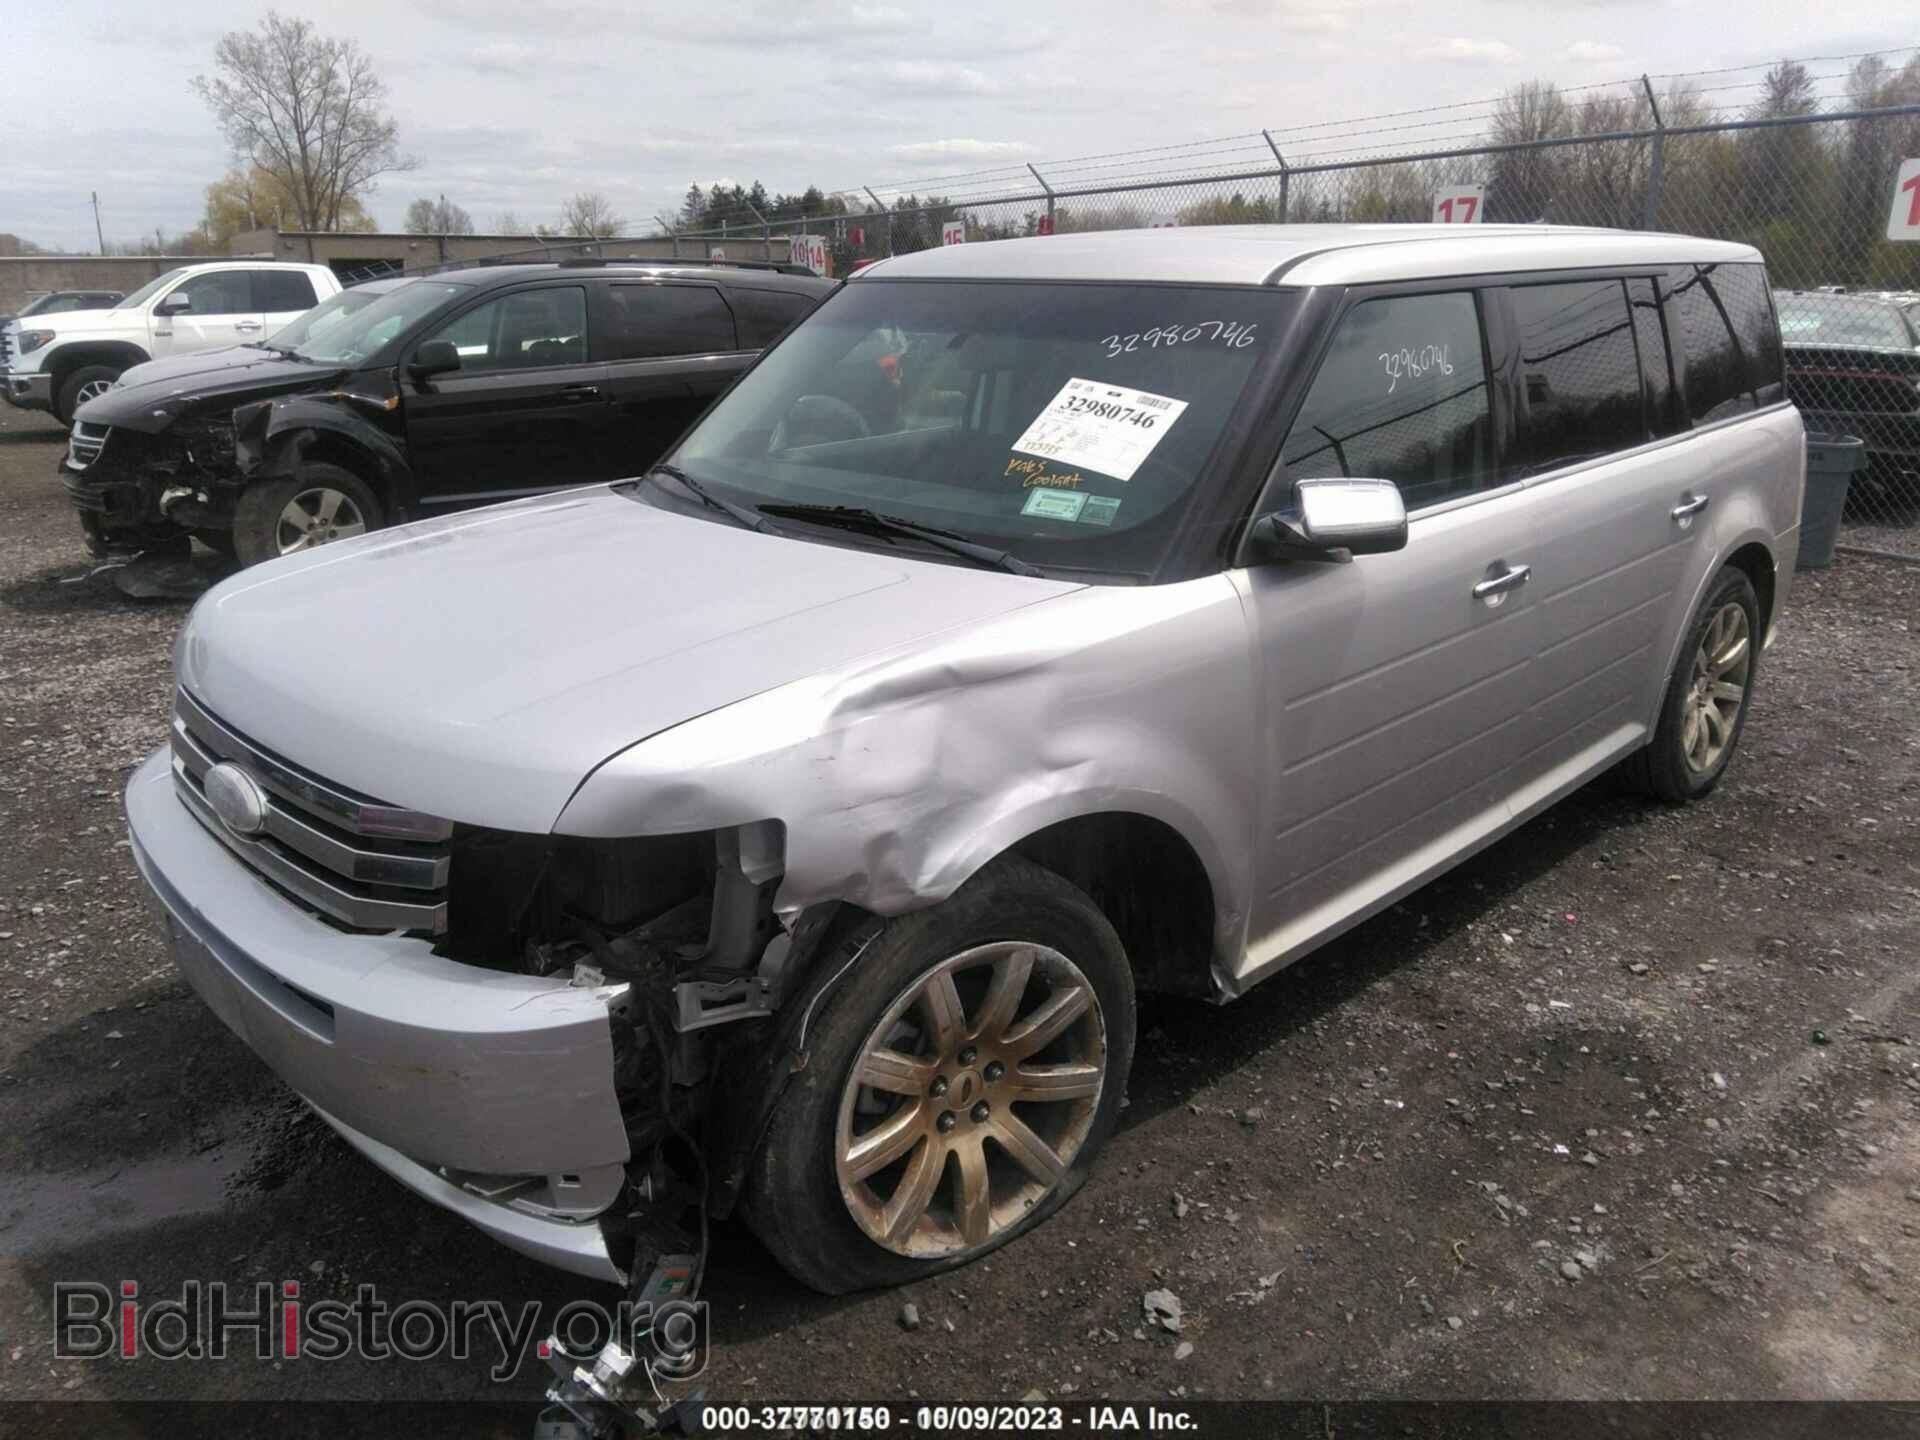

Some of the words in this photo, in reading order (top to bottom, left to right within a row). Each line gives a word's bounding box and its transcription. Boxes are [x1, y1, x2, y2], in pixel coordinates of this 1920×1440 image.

[1438, 197, 1478, 224] 17
[1100, 321, 1257, 358] 32980746
[1060, 396, 1159, 429] 32980746
